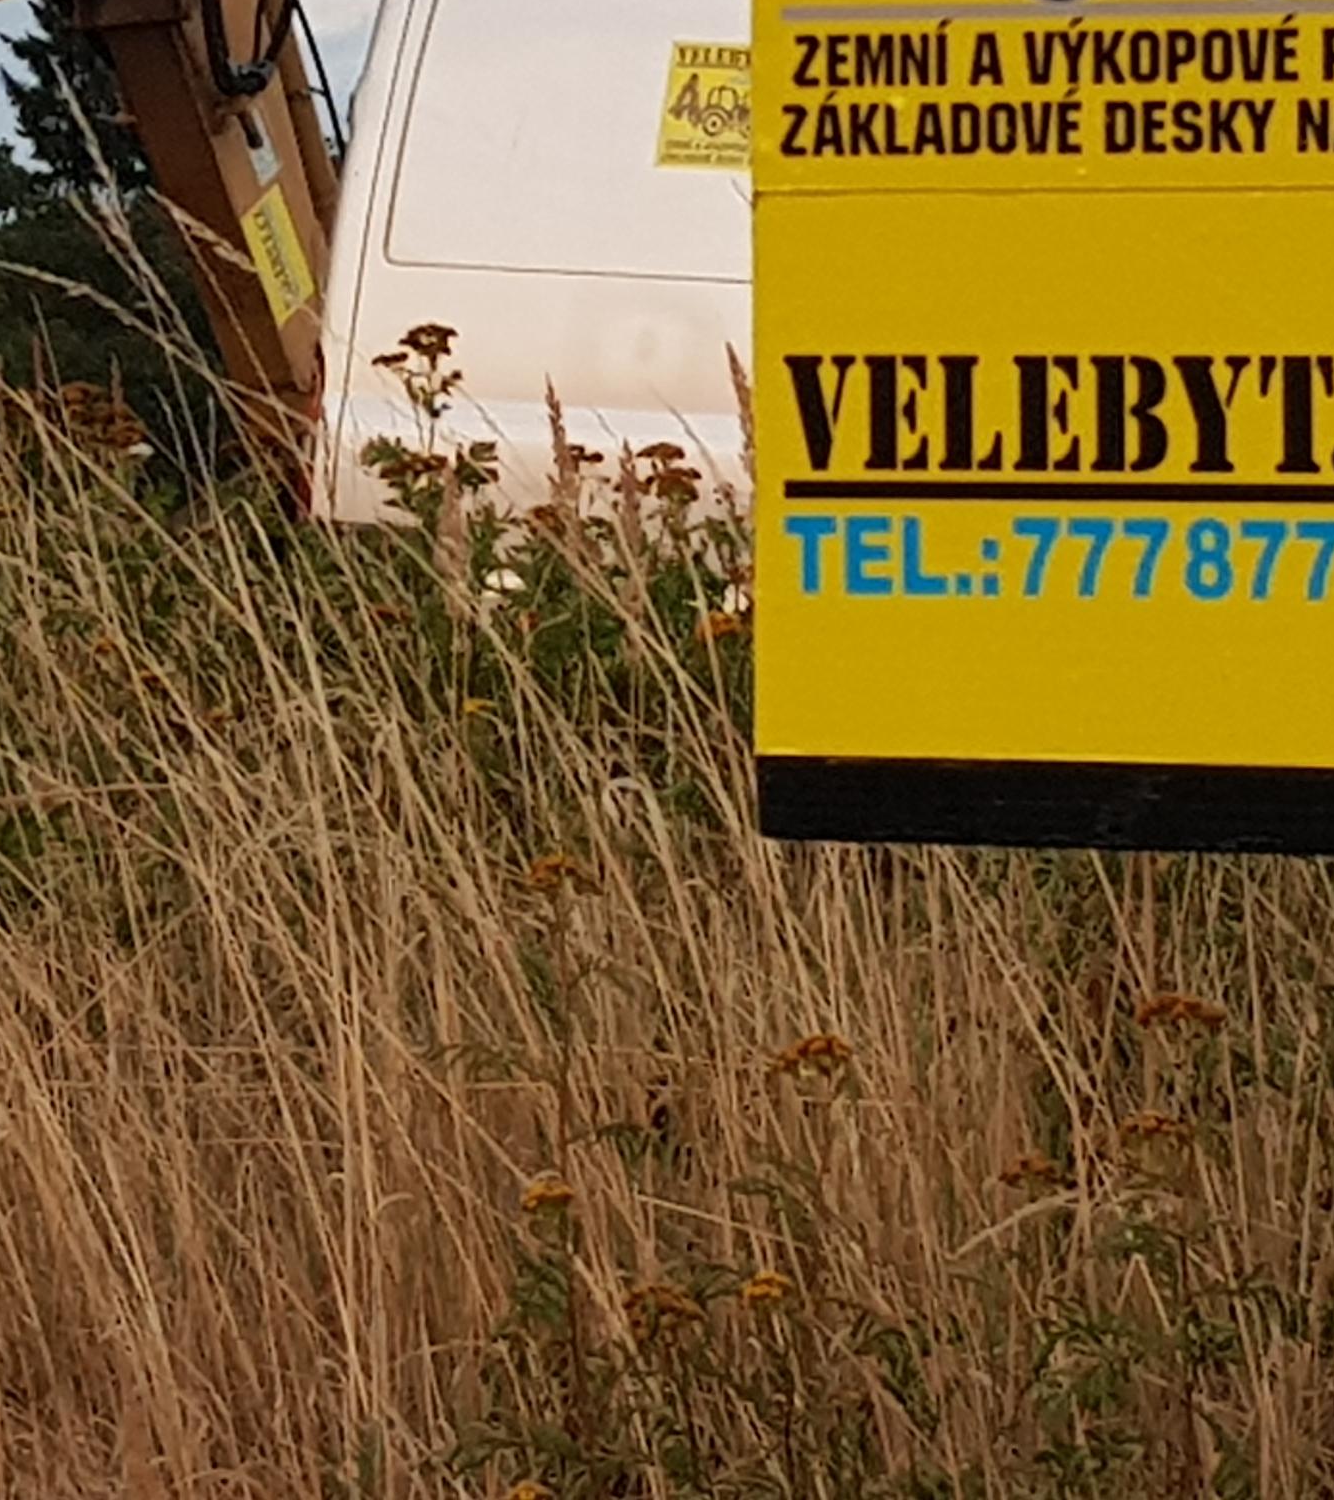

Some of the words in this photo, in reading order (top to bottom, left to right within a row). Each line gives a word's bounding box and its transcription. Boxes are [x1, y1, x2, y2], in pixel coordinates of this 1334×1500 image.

[792, 18, 950, 88] ZEMNÍ
[968, 31, 1005, 86] A
[1022, 12, 1300, 86] VÝKOPOVÉ
[779, 88, 1083, 158] ZÁKLADOVÉ
[1103, 98, 1276, 155] DESKY
